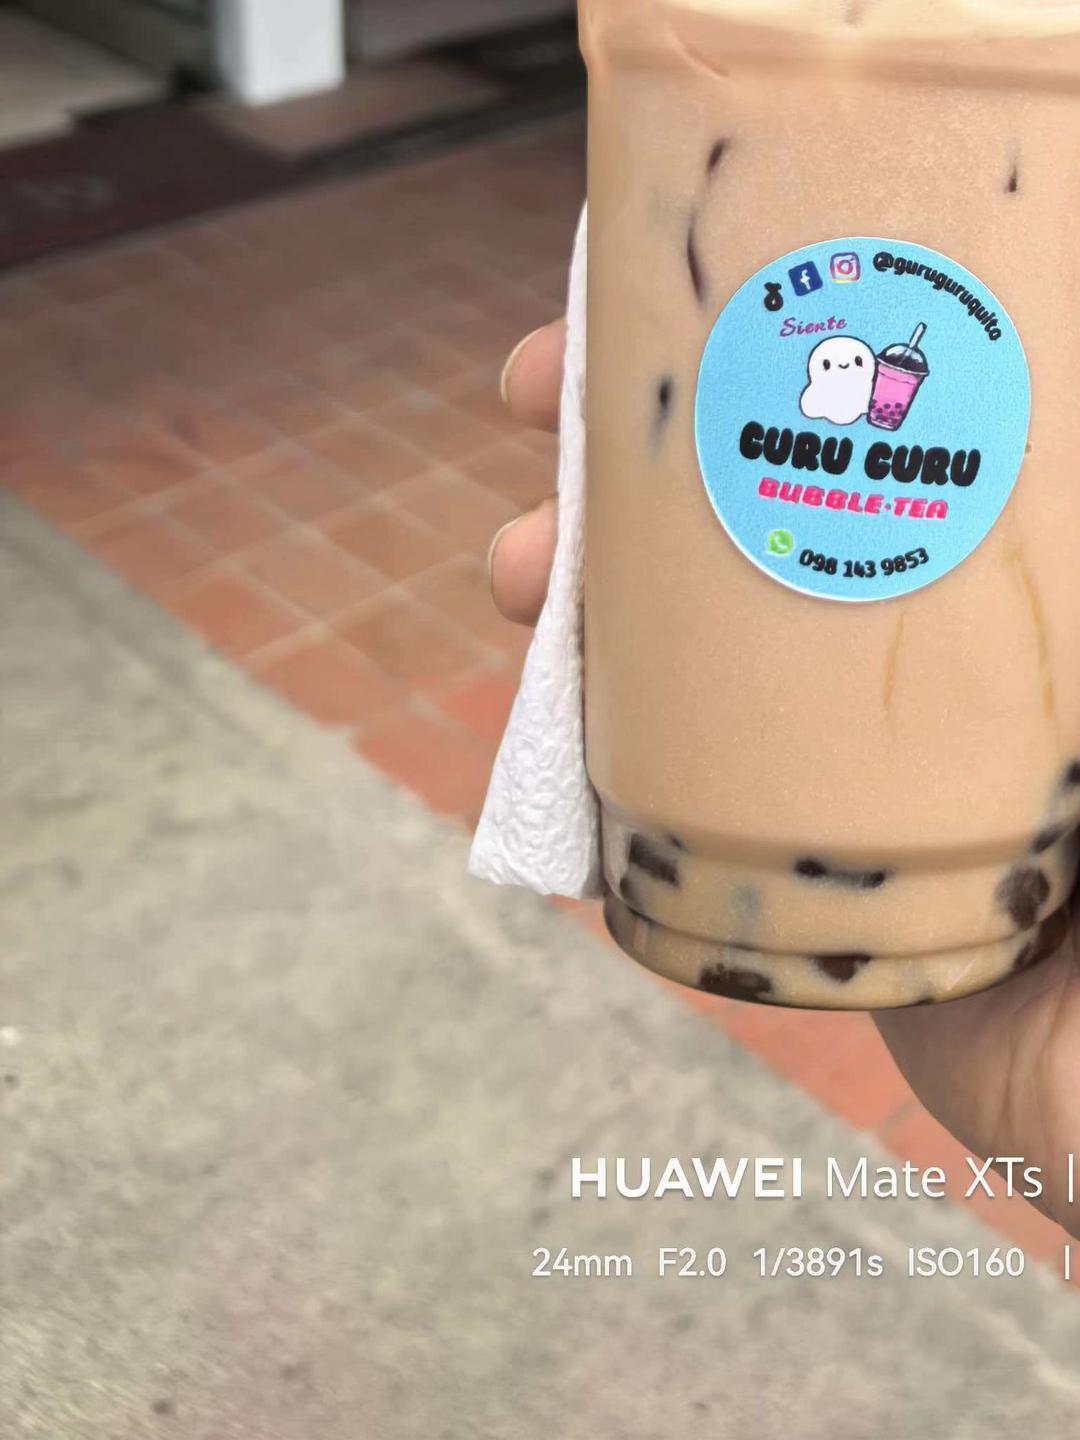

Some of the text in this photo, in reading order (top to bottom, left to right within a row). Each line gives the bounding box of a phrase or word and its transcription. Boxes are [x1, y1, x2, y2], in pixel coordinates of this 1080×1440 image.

[872, 251, 1002, 341] @guruguruquito
[779, 315, 848, 337] Siente
[799, 546, 930, 579] 098 143 9853
